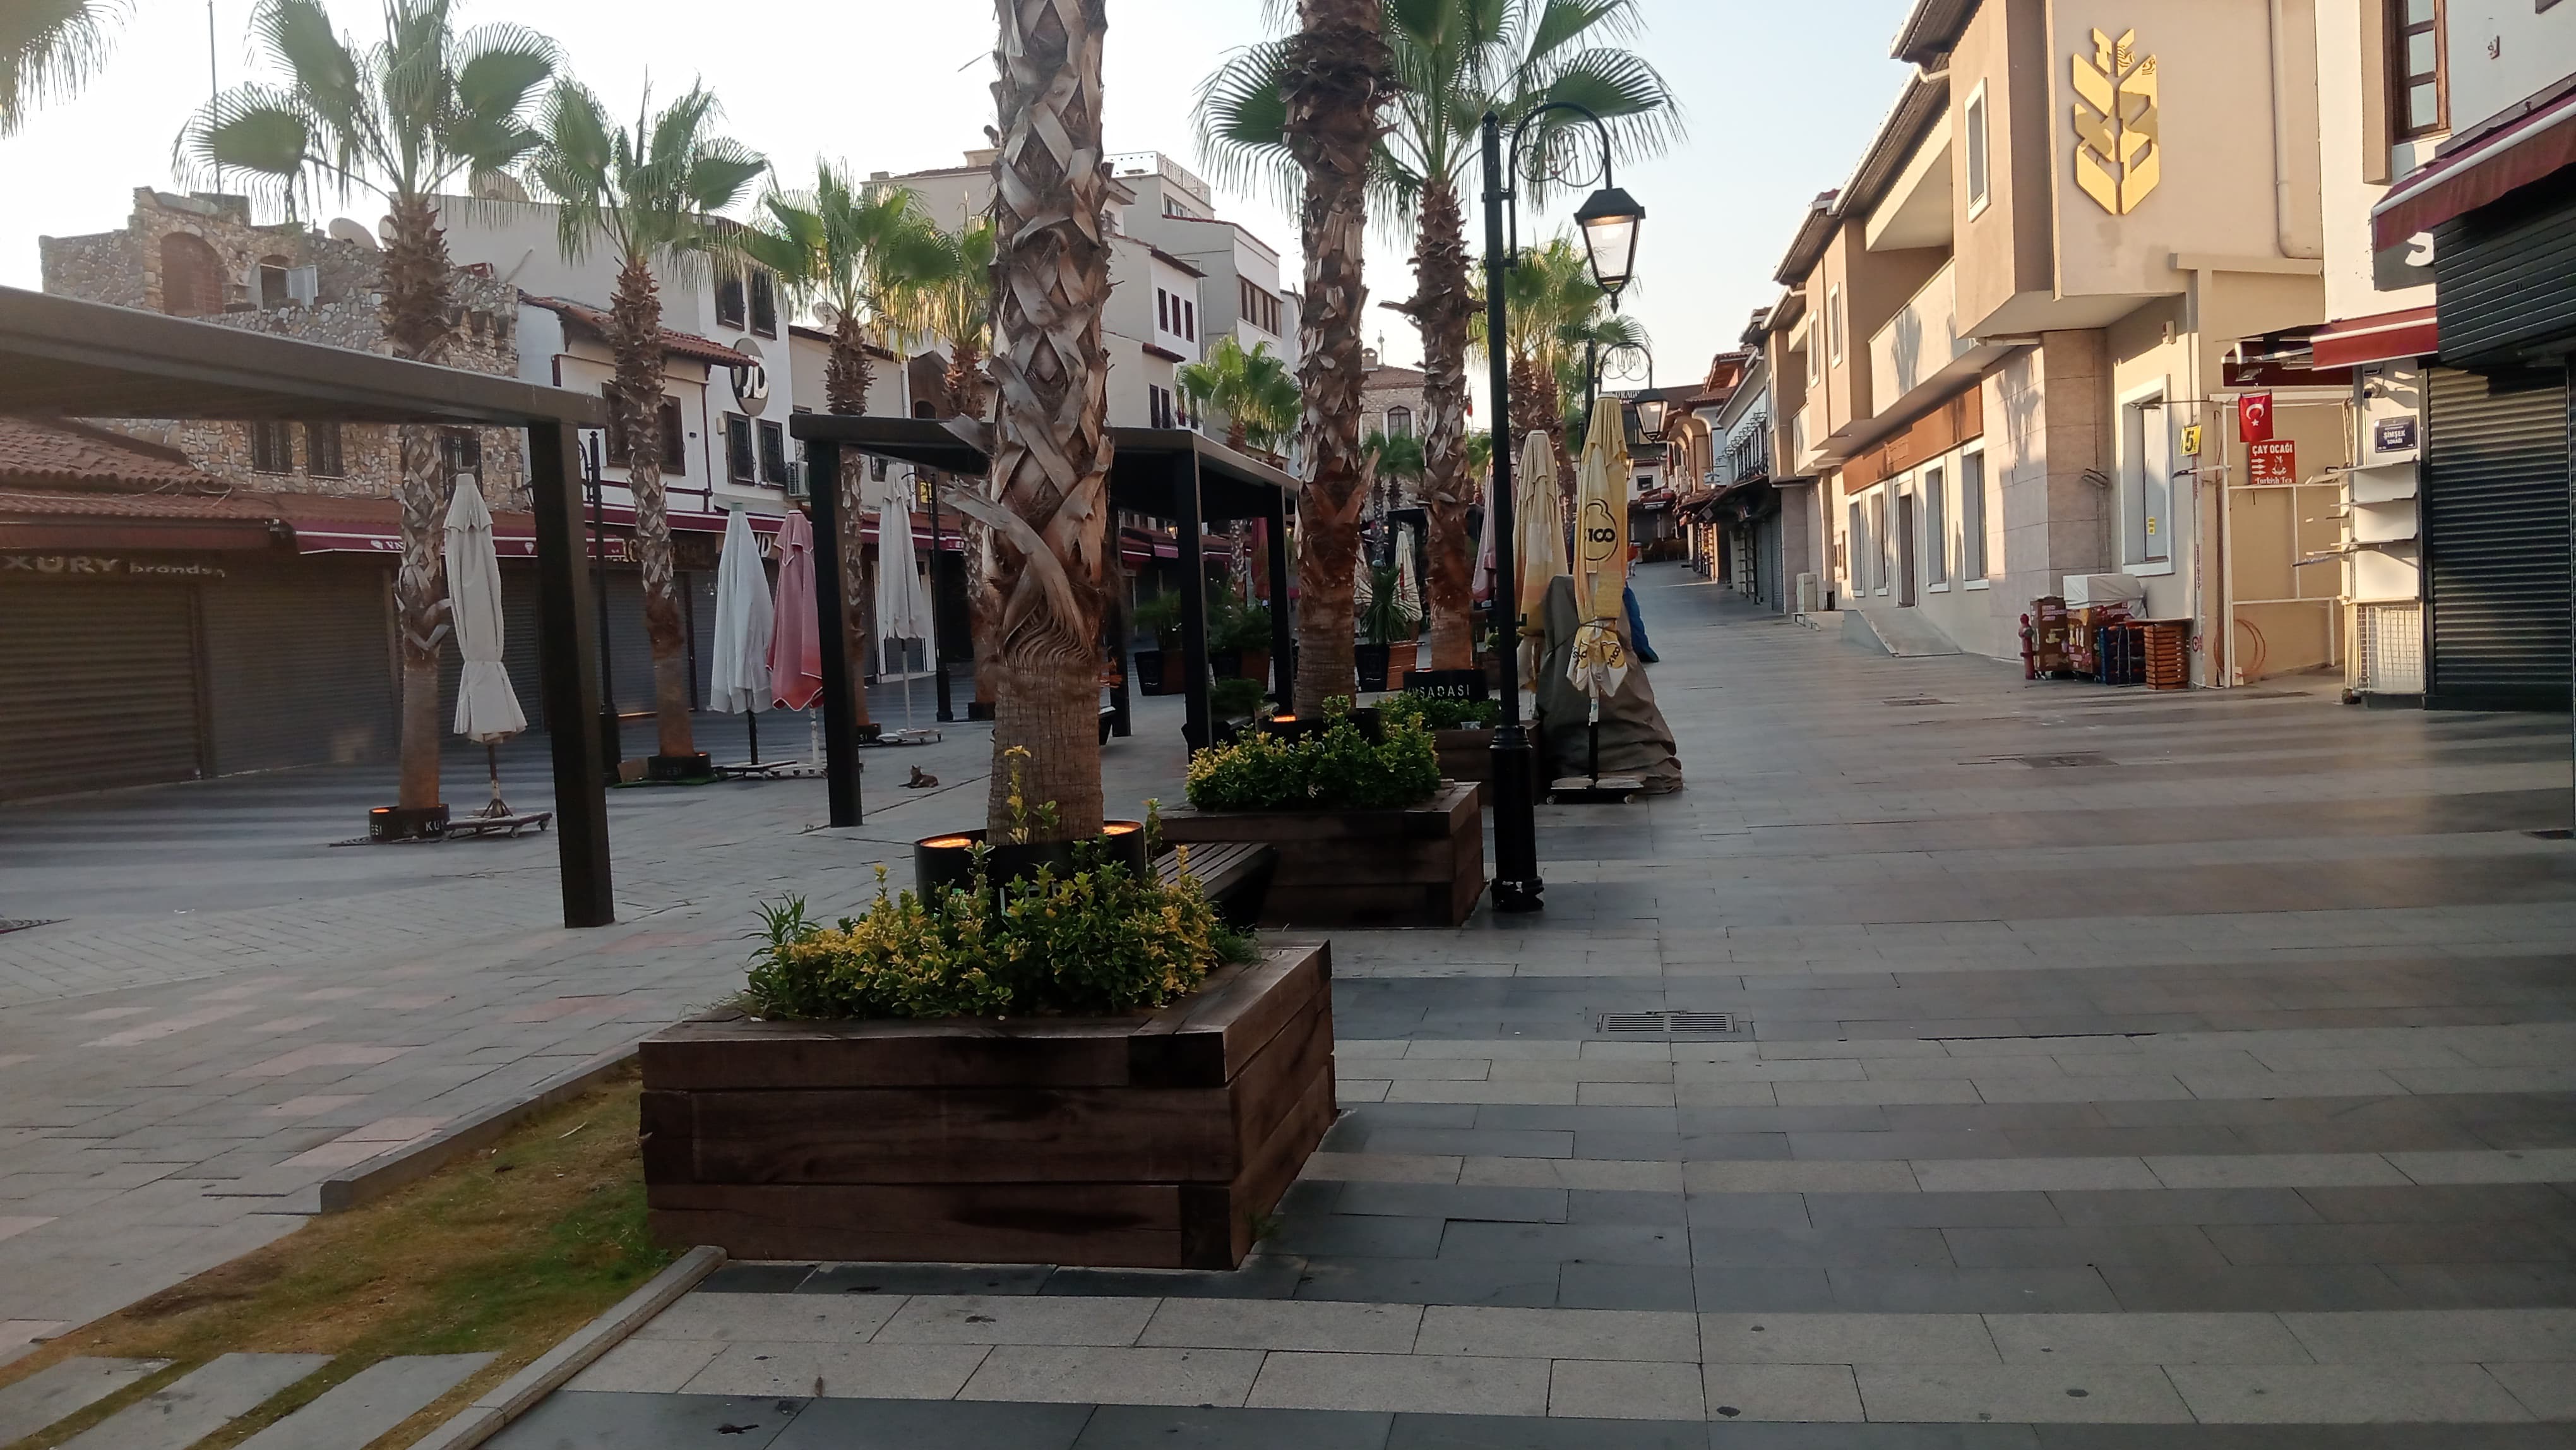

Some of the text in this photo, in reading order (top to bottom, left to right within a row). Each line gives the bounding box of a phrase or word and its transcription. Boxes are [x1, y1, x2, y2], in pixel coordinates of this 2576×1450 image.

[2185, 430, 2194, 452] 5
[2252, 443, 2293, 457] ÇAY OCAĞI
